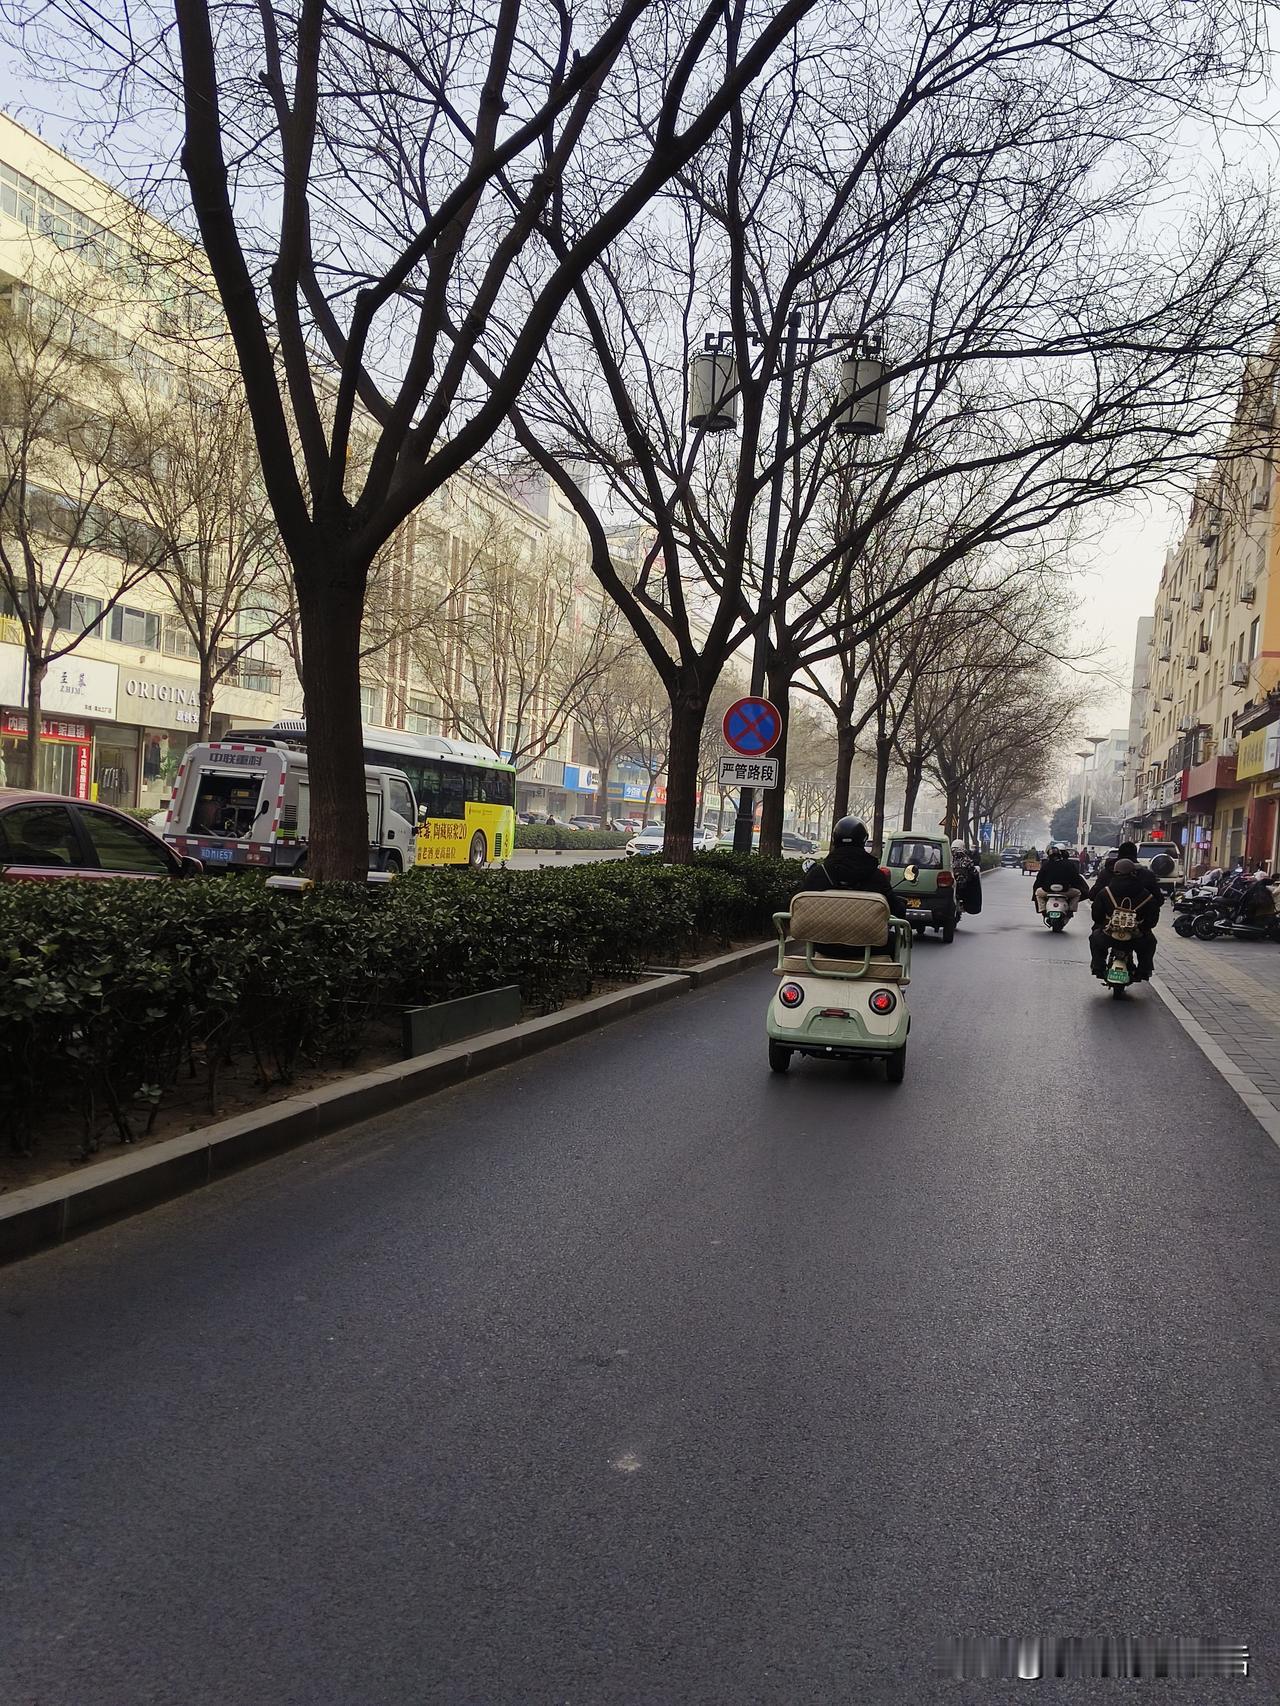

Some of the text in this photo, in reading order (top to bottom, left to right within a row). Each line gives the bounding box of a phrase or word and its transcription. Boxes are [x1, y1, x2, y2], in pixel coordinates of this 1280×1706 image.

[209, 752, 262, 766] 中联重科
[720, 762, 774, 782] 严管路段
